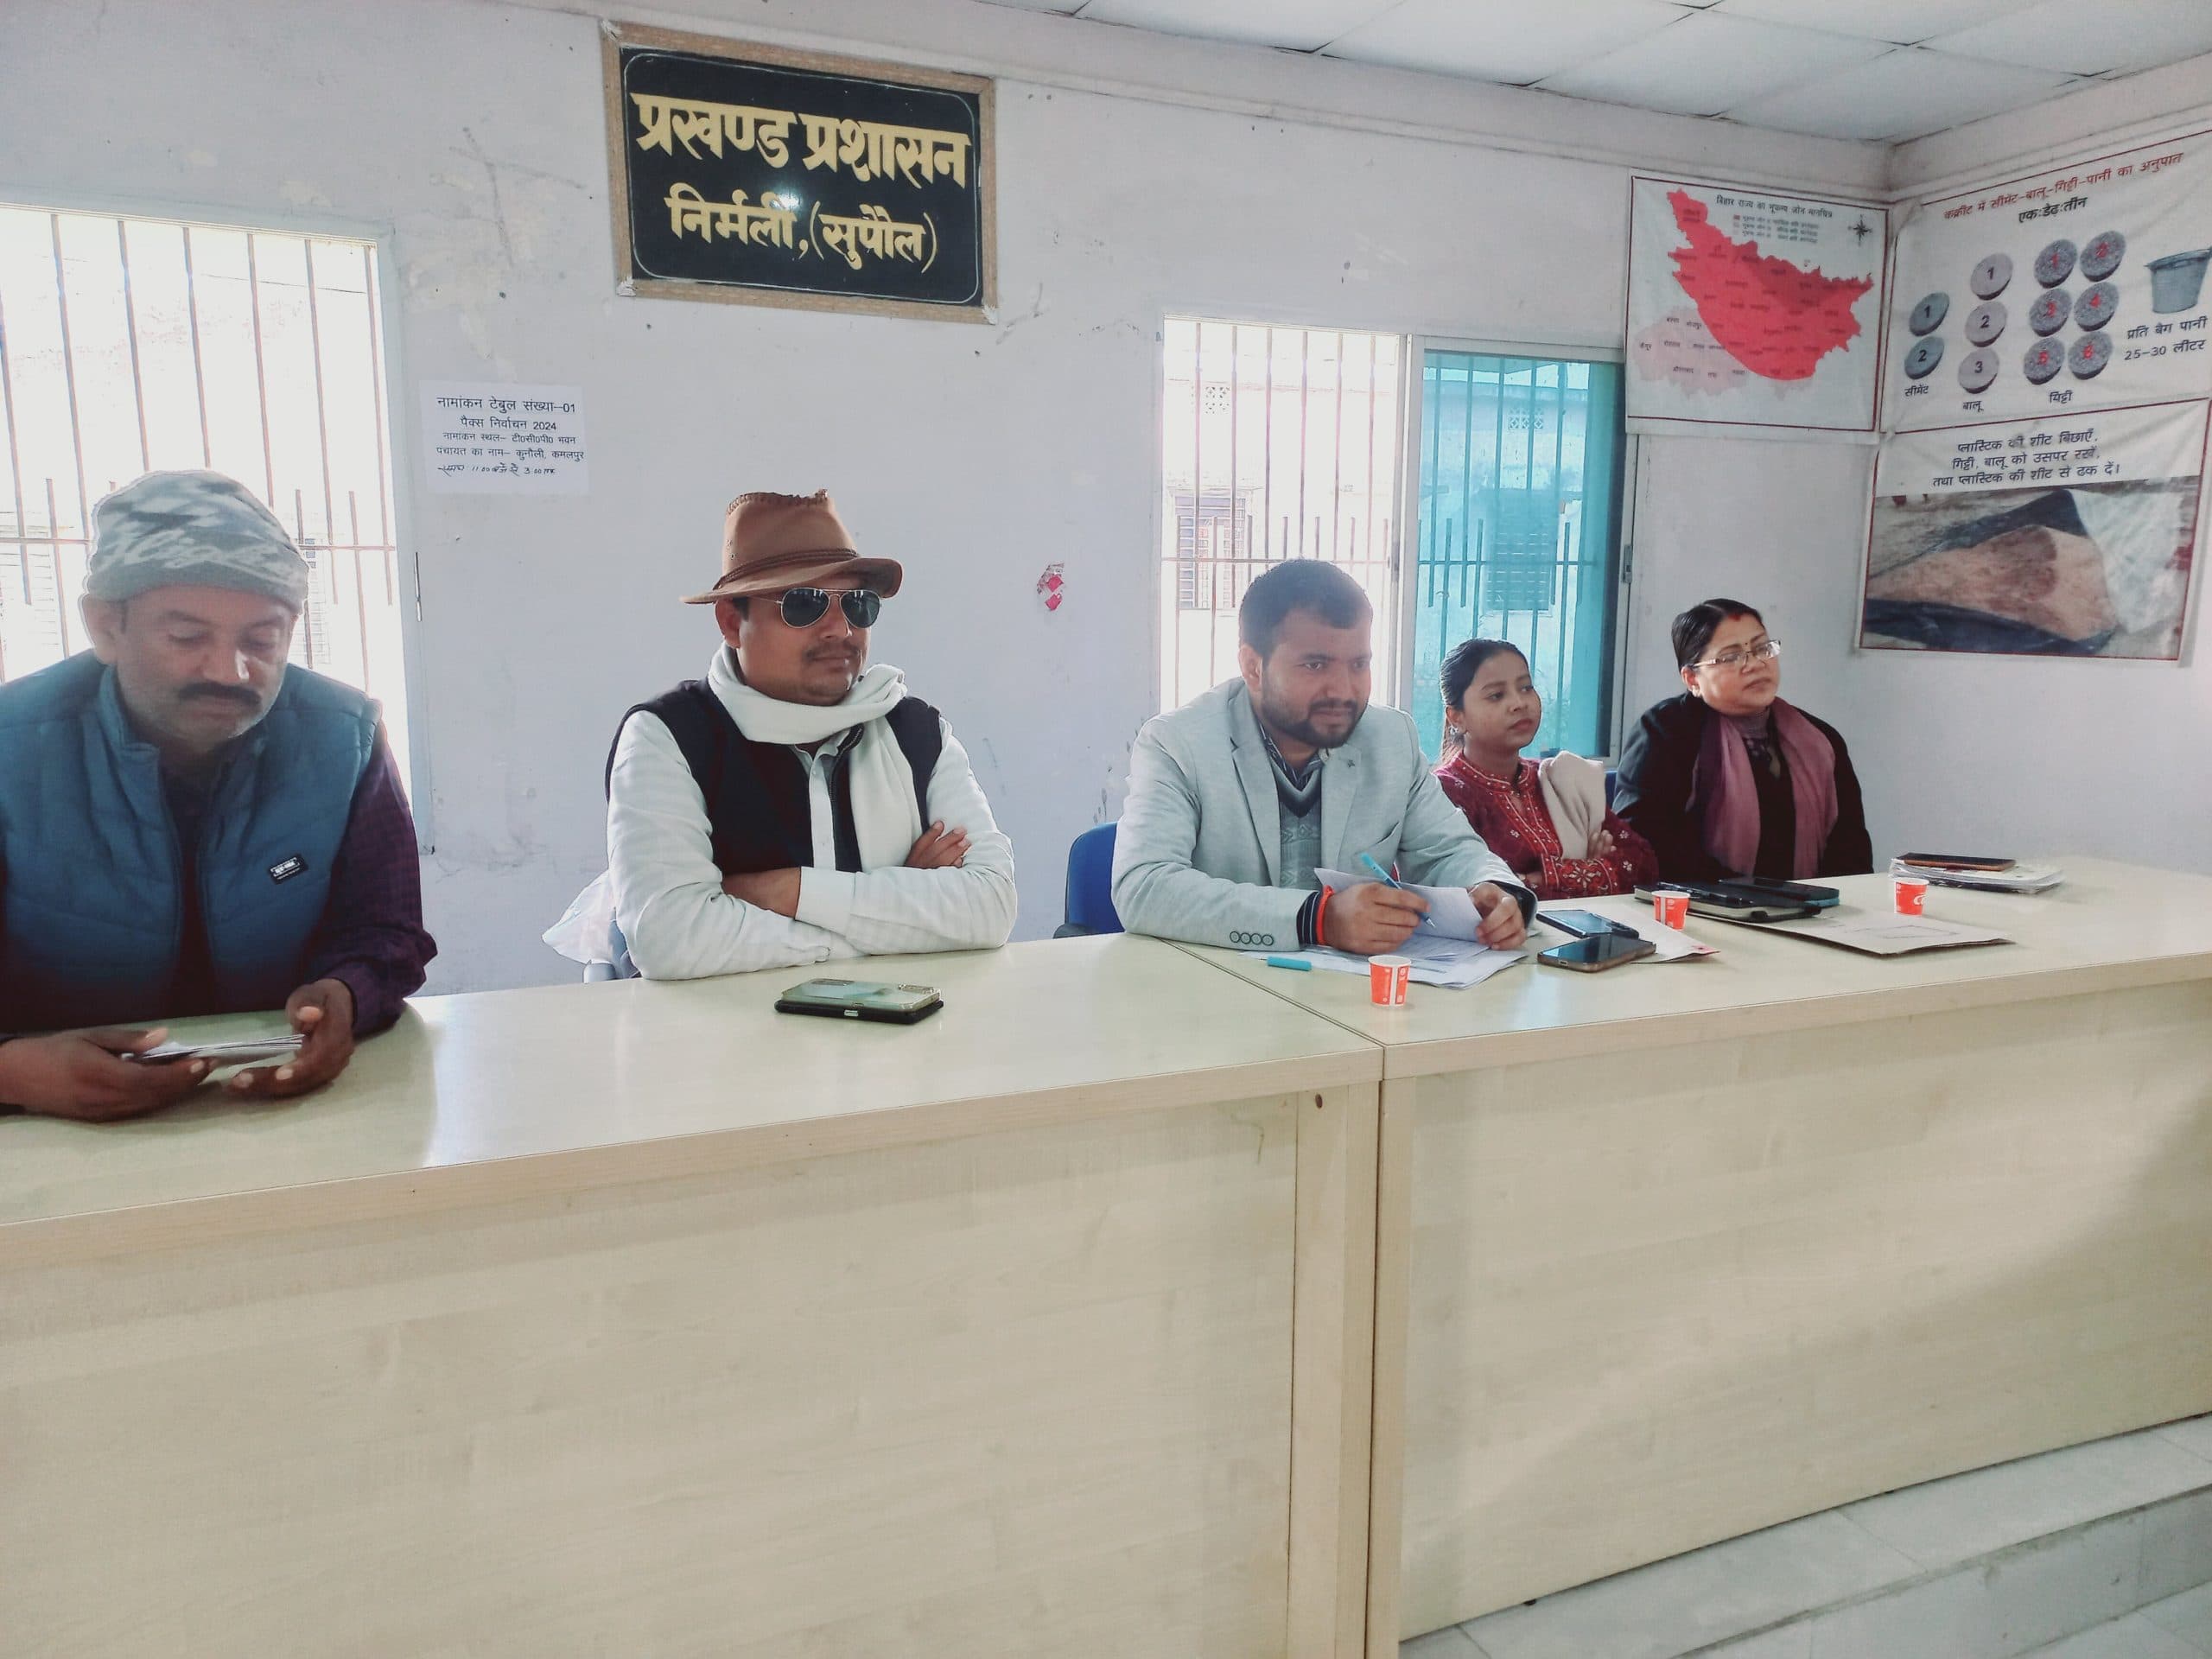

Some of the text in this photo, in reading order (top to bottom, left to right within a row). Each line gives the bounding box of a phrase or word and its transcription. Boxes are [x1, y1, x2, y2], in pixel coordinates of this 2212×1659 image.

[631, 92, 971, 188] प्रखण्ड प्रशासन
[2117, 164, 2134, 177] का
[2140, 152, 2183, 173] अनुपात
[1987, 266, 1994, 280] 1
[1924, 305, 1931, 318] 1
[1980, 315, 1990, 328] 2
[2127, 325, 2150, 340] प्रति
[2179, 315, 2208, 332] पानी
[2173, 339, 2207, 353] लीटर
[1917, 349, 1927, 363] 2
[1974, 360, 1983, 373] 3
[1904, 385, 1929, 397] सीमेंट
[436, 396, 482, 408] नामांकन
[488, 396, 516, 413] टेबुल
[1963, 400, 1984, 412] बालू
[461, 415, 556, 430] पैक्स निर्वाचन 2024
[1958, 439, 2003, 452] प्लास्टिक
[2008, 435, 2024, 448] की
[2031, 434, 2053, 447] शीट
[436, 446, 466, 455] पंचायत
[471, 448, 482, 456] का
[551, 451, 584, 461] कमलपुर
[1984, 457, 2009, 469] बालू
[2012, 452, 2027, 465] को
[2033, 450, 2069, 463] उसपर
[1933, 476, 1954, 486] तथा
[1959, 472, 2004, 484] प्लास्टिक
[2009, 468, 2025, 481] की
[2031, 467, 2053, 480] शीट
[2059, 466, 2071, 478] से
[2076, 466, 2098, 476] ढक
